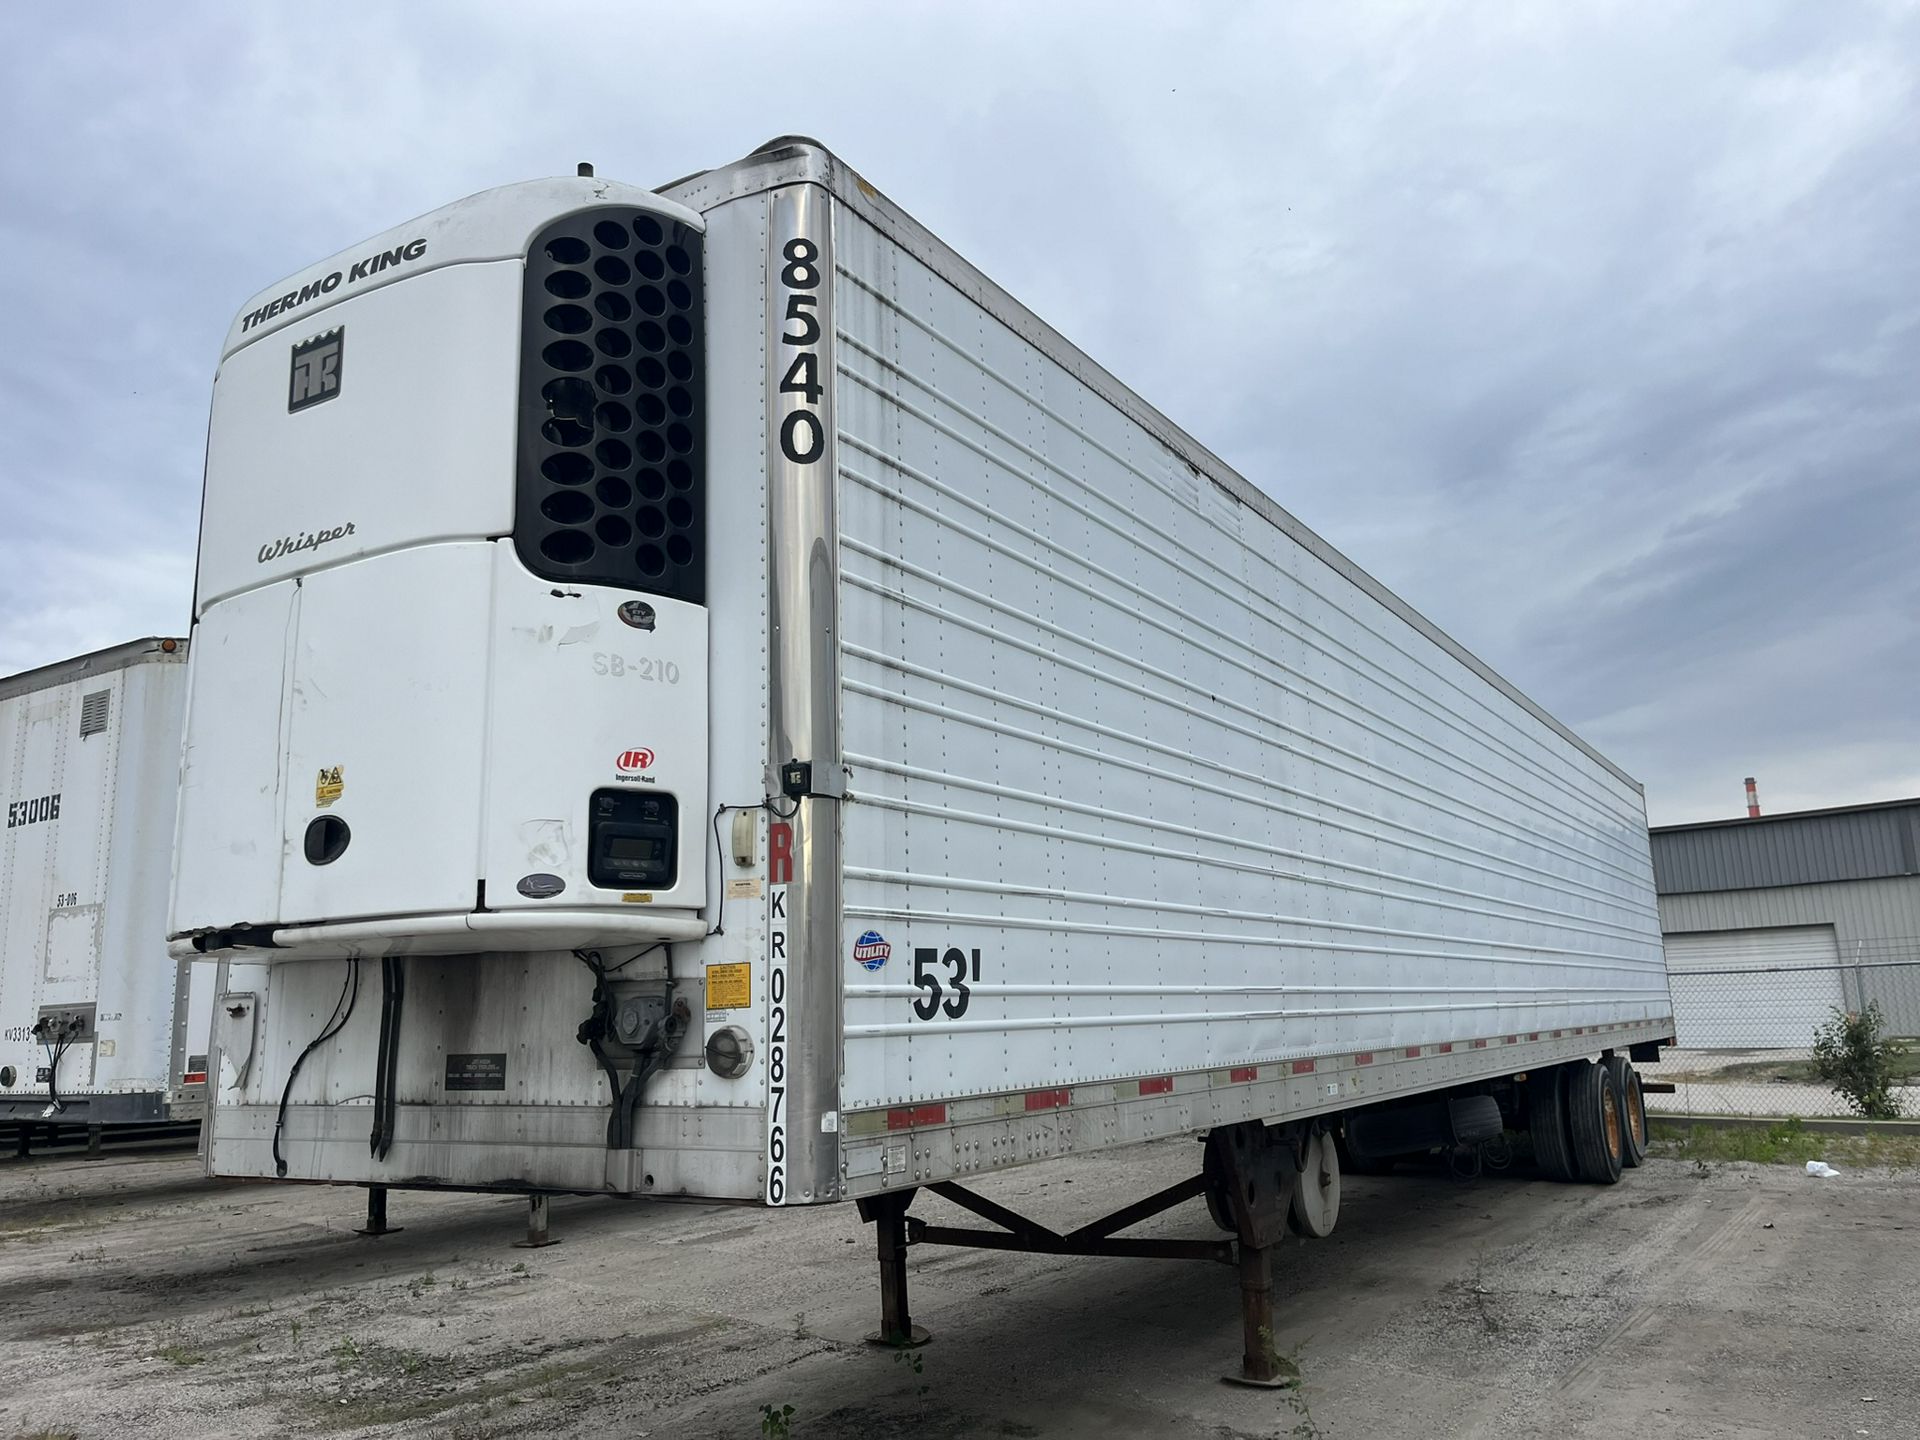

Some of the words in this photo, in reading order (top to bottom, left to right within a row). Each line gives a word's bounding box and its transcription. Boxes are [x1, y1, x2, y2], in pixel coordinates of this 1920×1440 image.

[241, 271, 343, 334] THERMO
[348, 238, 428, 284] KING
[780, 237, 825, 464] 8540
[258, 522, 355, 564] Whisper
[592, 651, 680, 685] SB-210
[615, 773, 655, 784] Ingersoll-Rand
[622, 751, 649, 769] IR
[7, 793, 61, 829] 53006
[855, 943, 890, 959] UTILITY
[912, 947, 981, 1021] 53'
[769, 891, 787, 1204] KR028766
